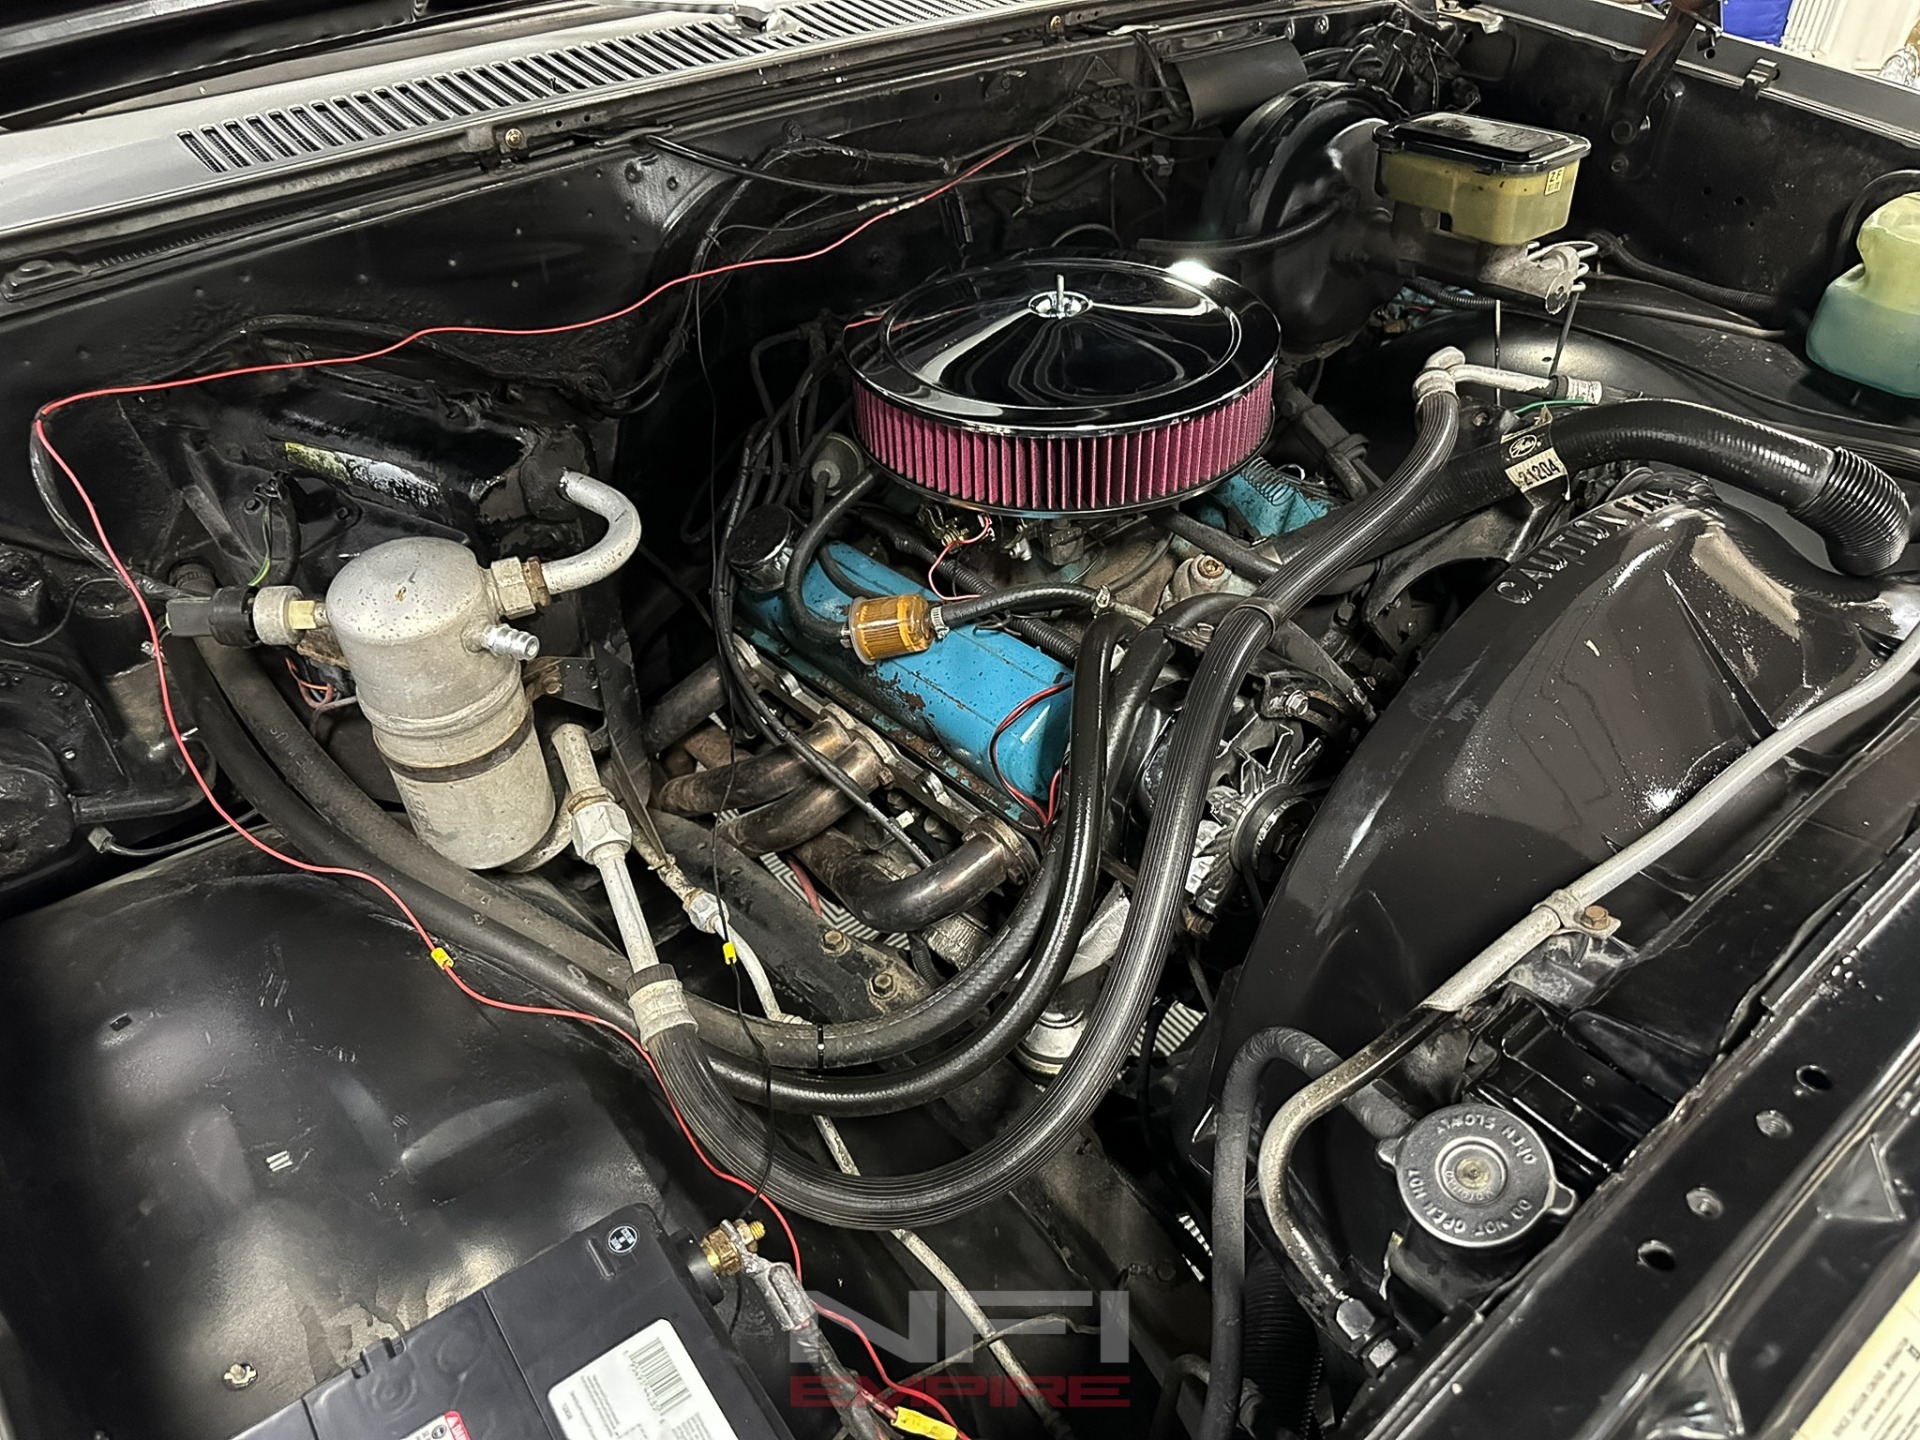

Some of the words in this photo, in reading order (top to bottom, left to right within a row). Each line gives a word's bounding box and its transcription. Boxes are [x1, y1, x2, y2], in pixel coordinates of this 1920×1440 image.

[1549, 169, 1562, 183] ZF
[1518, 458, 1561, 486] 21204
[1496, 511, 1632, 604] CAUTION
[1407, 1168, 1428, 1201] HOT
[1424, 1202, 1467, 1234] OPEN
[1511, 1199, 1533, 1220] DO
[1473, 1217, 1510, 1237] NOT
